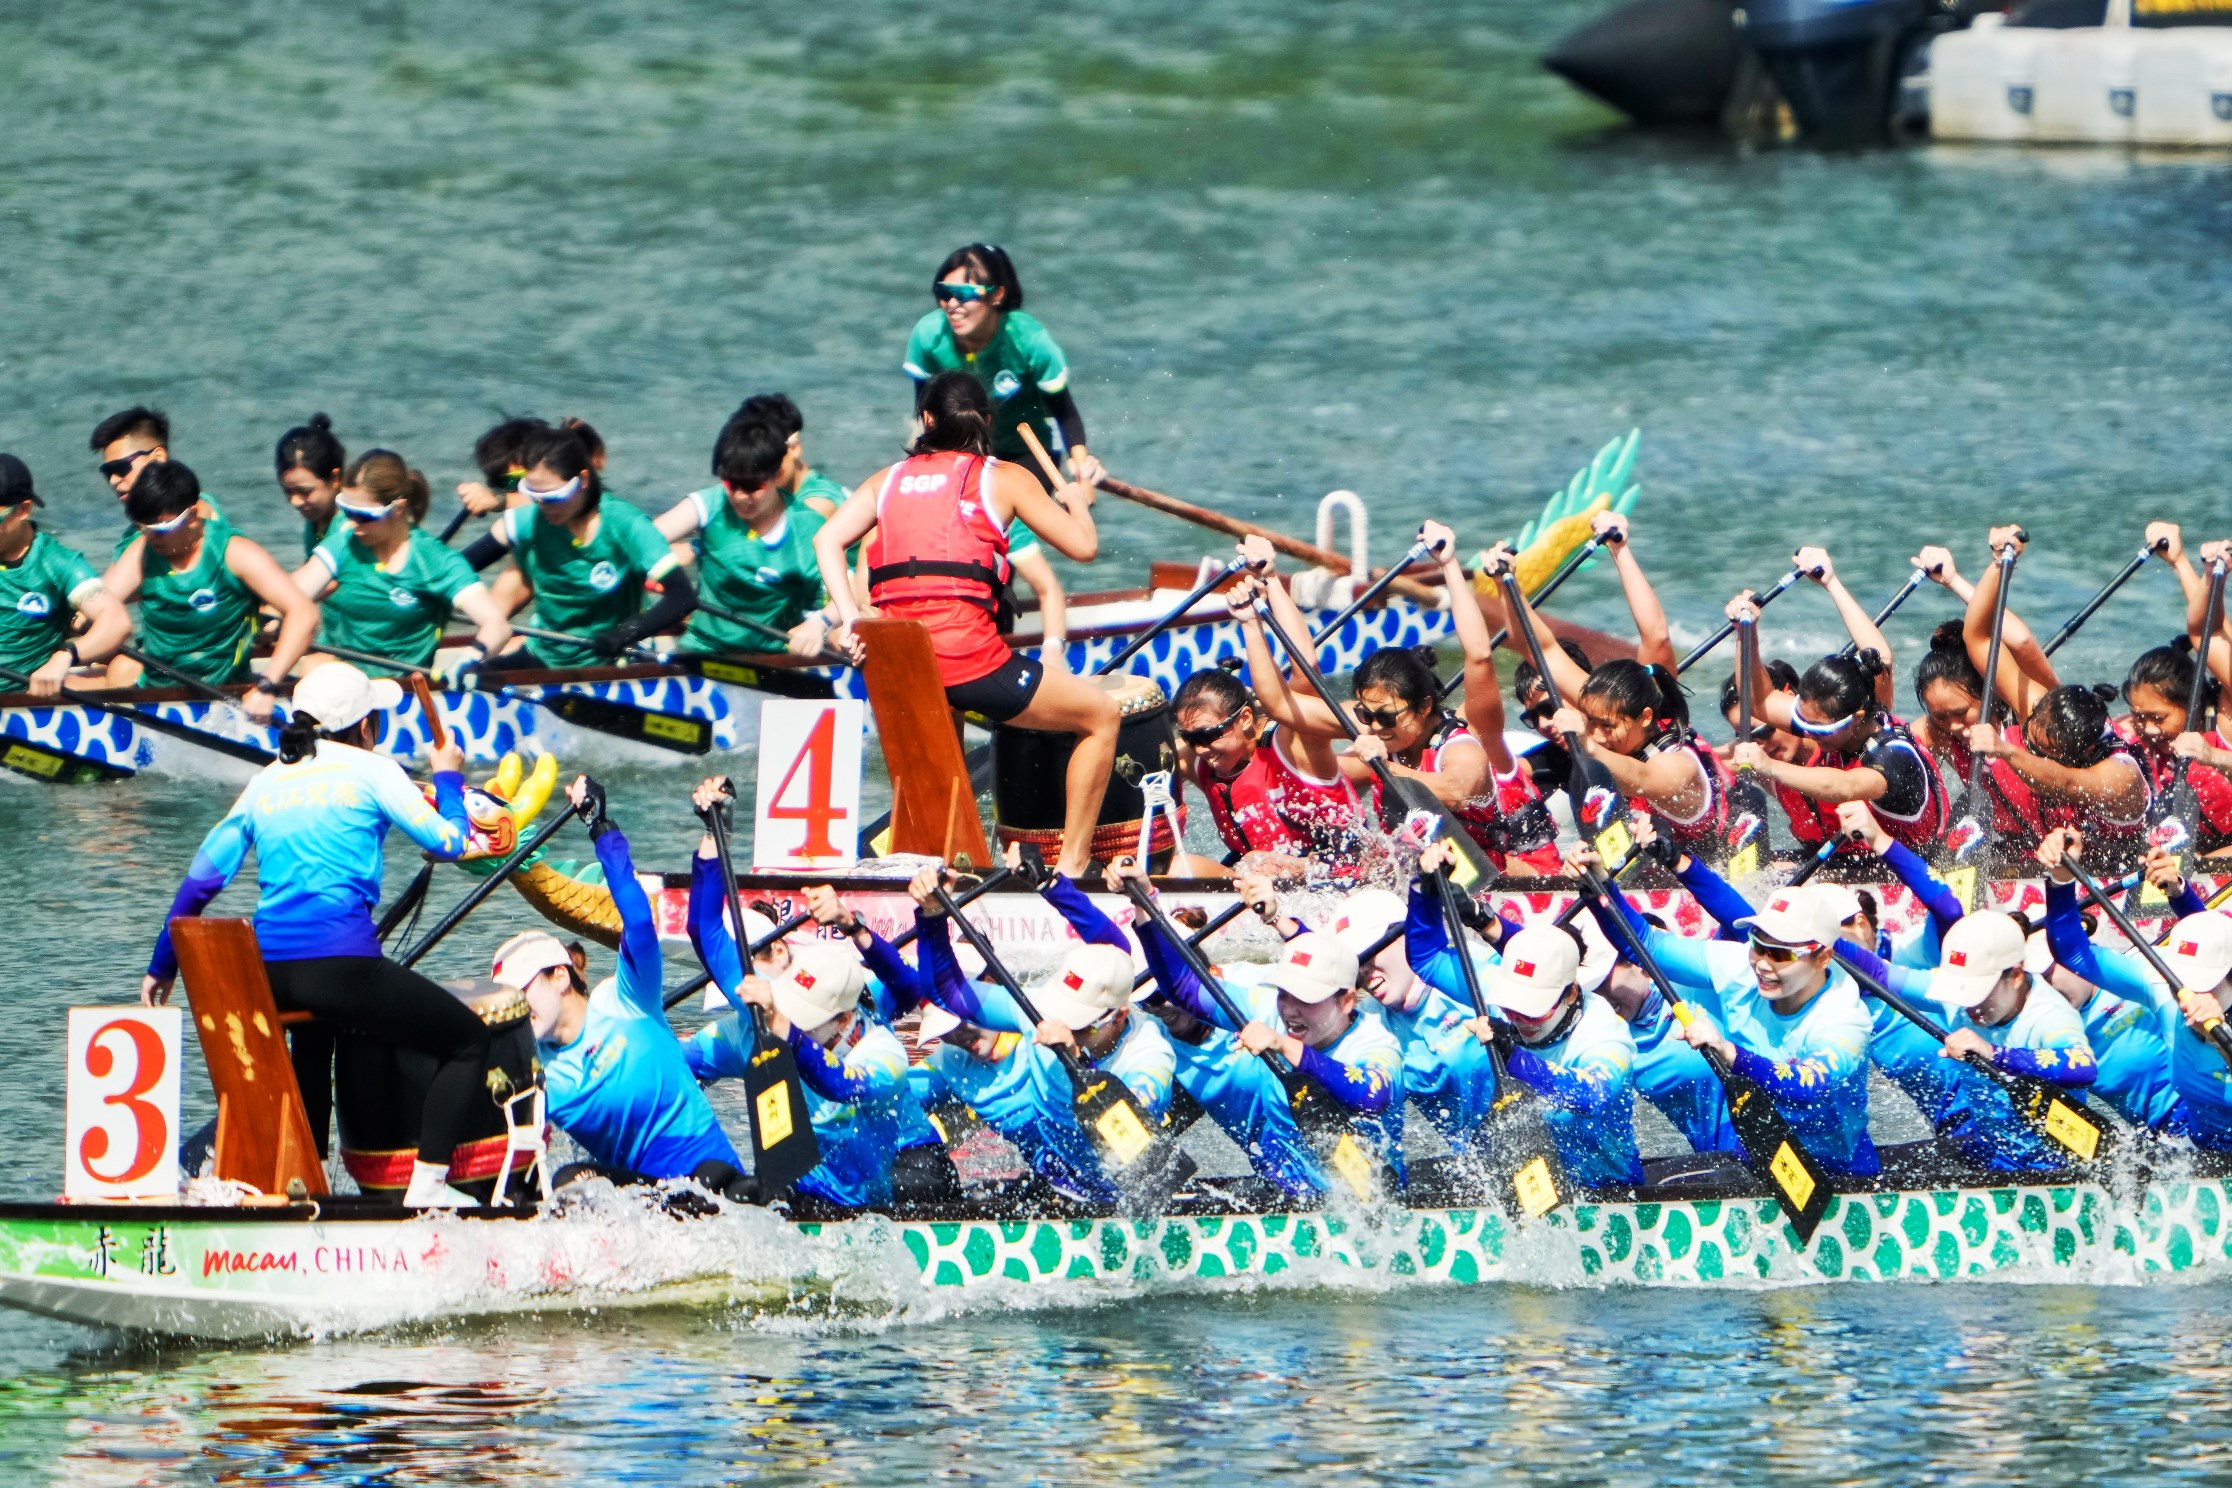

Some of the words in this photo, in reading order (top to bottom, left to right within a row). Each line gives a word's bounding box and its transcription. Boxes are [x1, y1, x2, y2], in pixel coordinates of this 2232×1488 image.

[899, 474, 947, 494] SGP
[768, 708, 847, 858] 4
[80, 1019, 167, 1184] 3
[314, 1246, 409, 1273] CHINA
